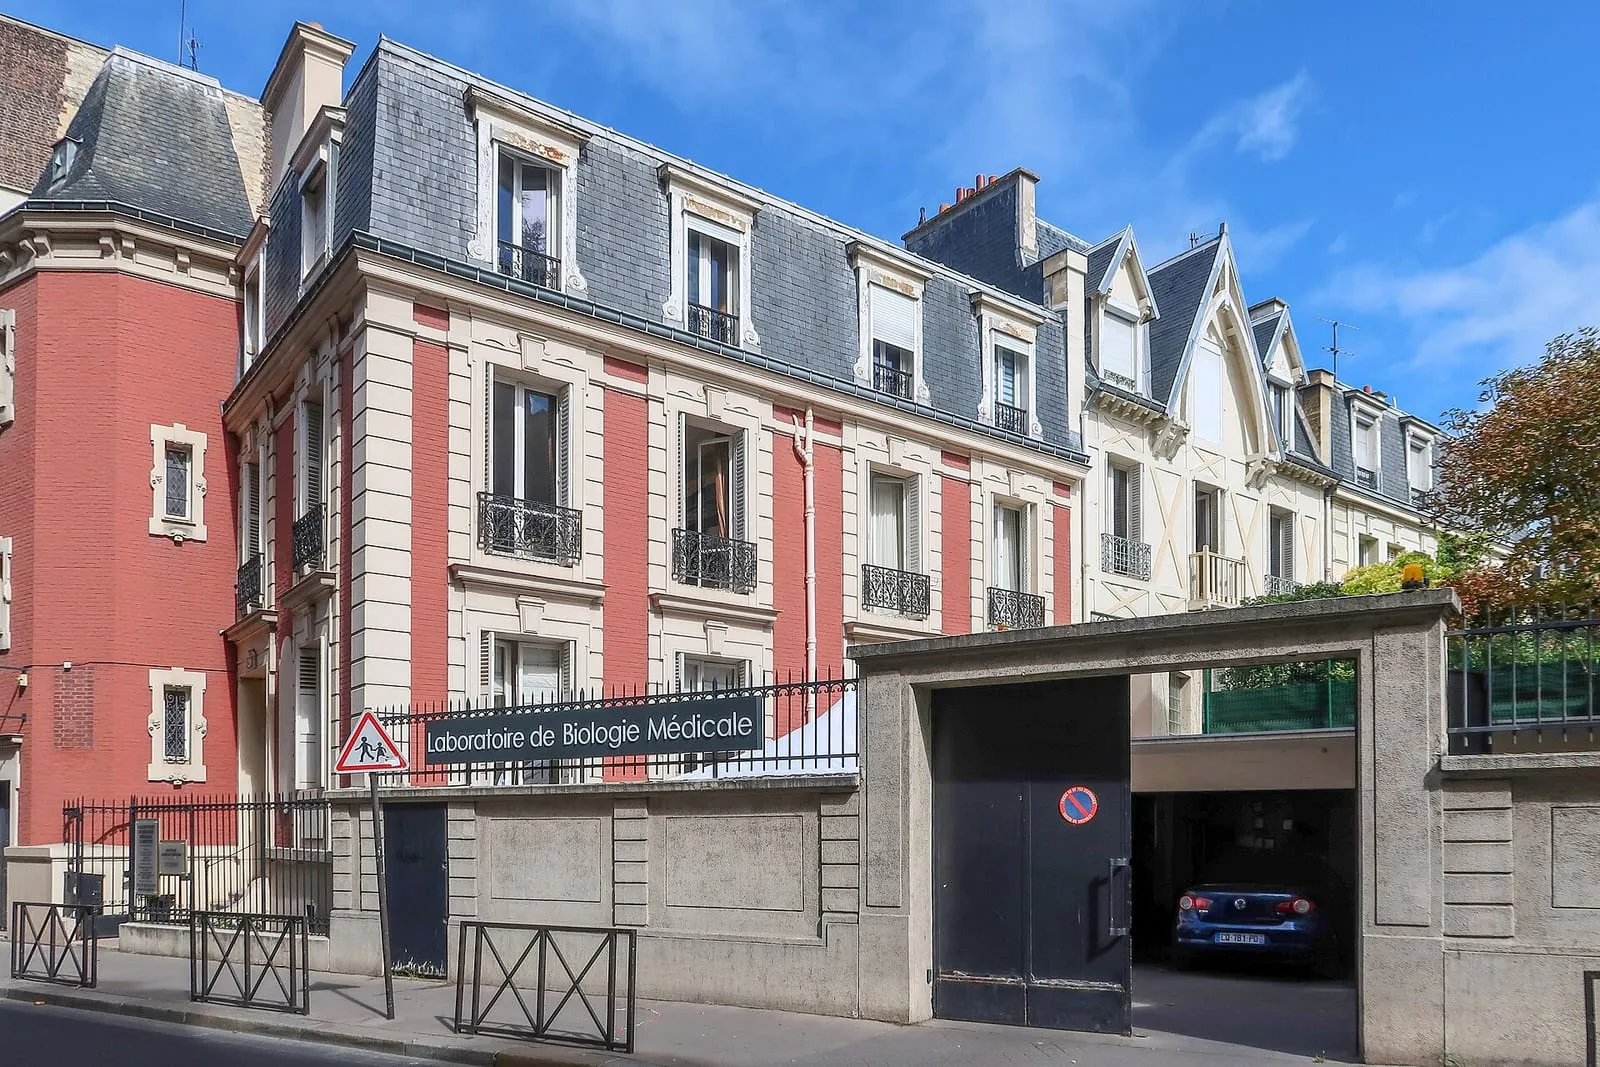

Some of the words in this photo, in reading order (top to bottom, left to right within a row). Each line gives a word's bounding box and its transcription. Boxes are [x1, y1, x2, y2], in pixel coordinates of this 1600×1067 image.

[427, 727, 525, 753] Laboratoire
[530, 725, 555, 748] de
[563, 718, 640, 749] Biologie
[647, 711, 753, 741] Médicale
